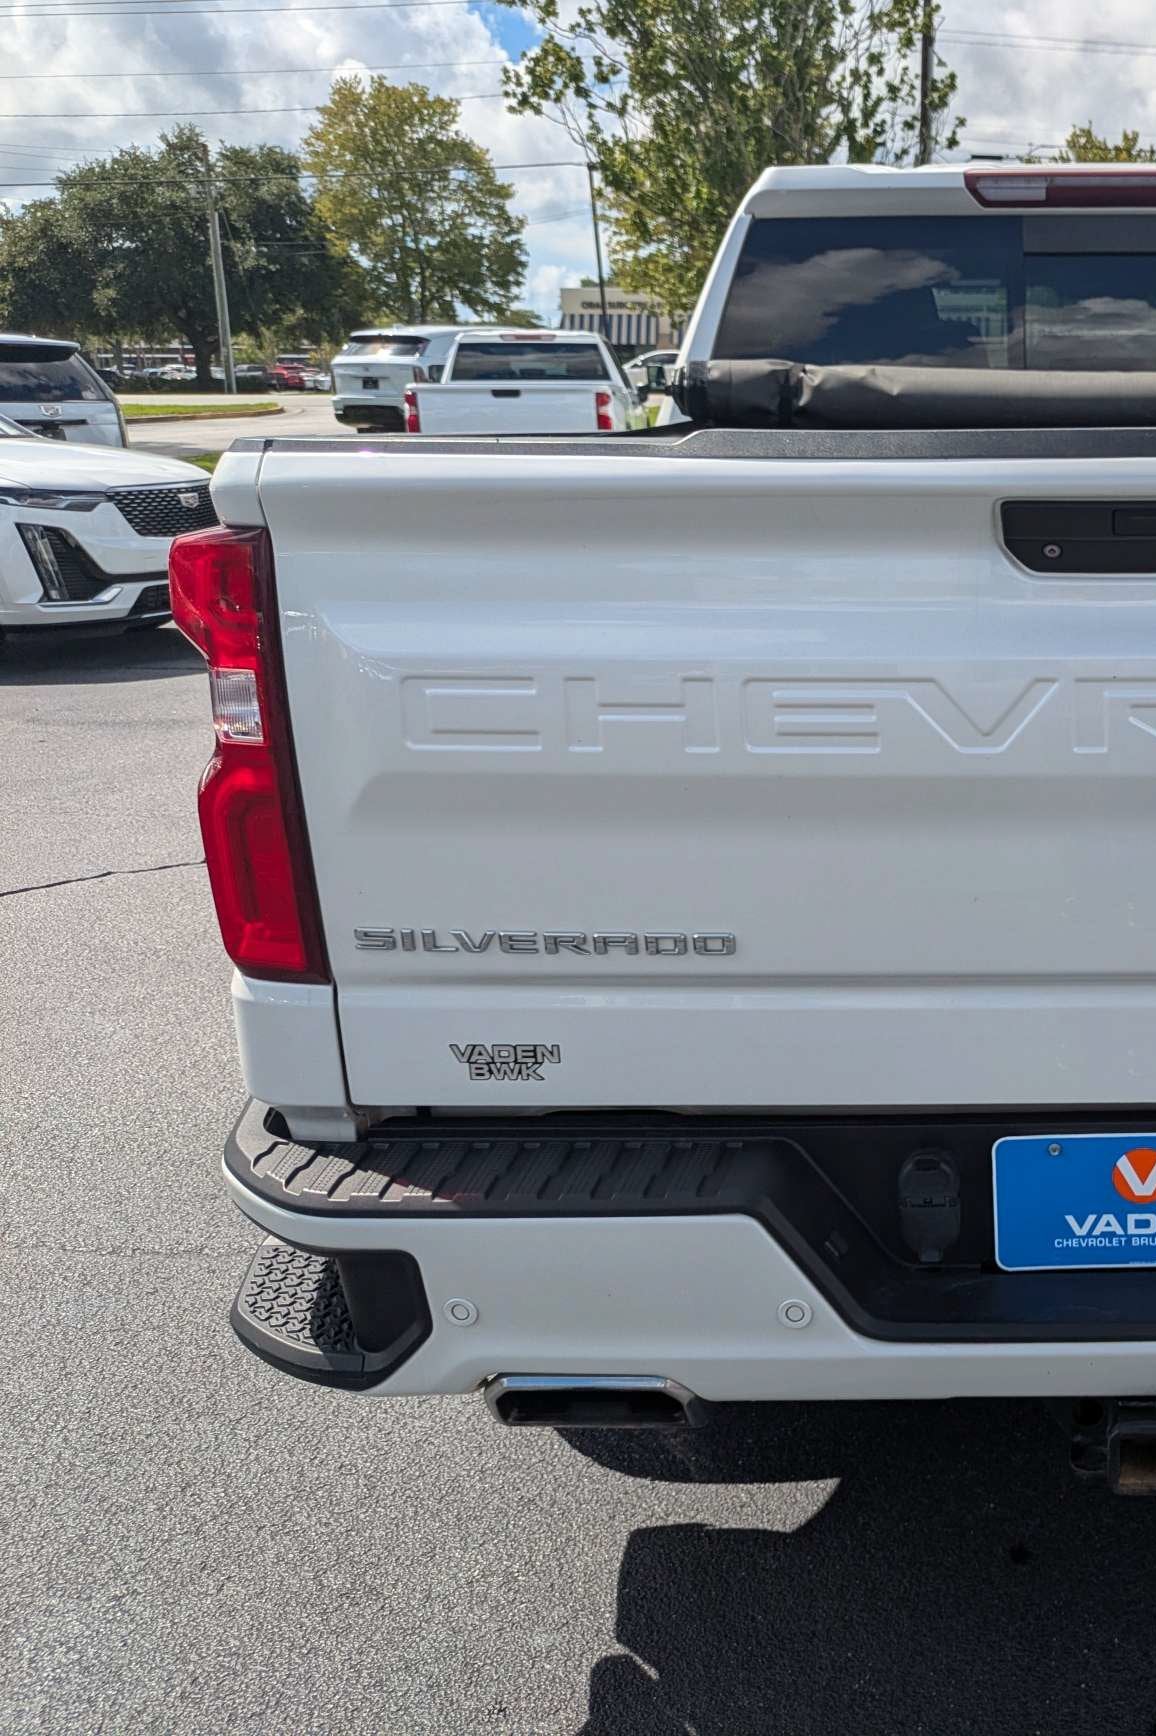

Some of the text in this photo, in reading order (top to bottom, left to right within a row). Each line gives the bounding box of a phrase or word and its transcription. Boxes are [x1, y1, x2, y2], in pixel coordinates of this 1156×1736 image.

[353, 926, 737, 957] SILVERADO
[449, 1044, 561, 1064] VADEN
[469, 1061, 546, 1081] BWK
[1054, 1236, 1128, 1248] CHEVROLET
